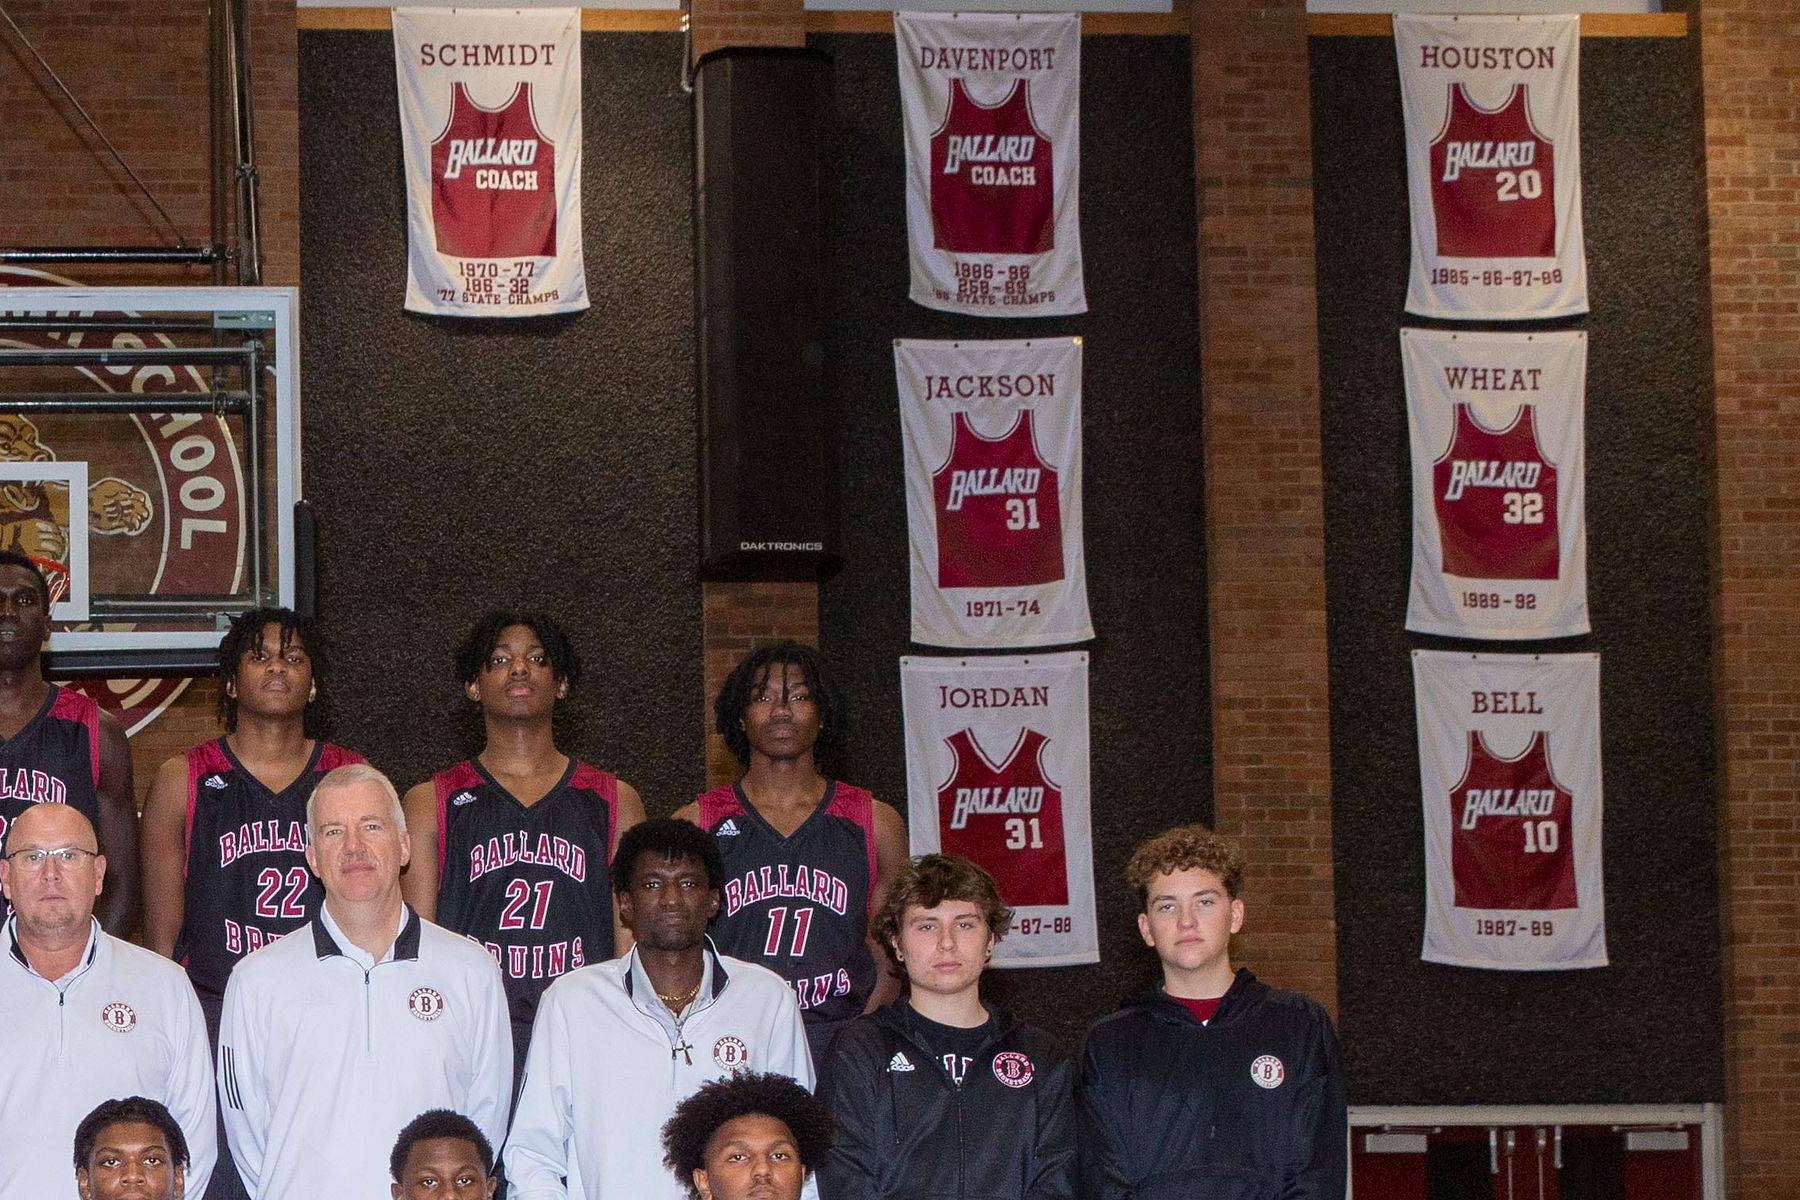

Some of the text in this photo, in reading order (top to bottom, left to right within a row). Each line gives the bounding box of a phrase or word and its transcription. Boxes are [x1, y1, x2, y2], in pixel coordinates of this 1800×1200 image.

[421, 44, 556, 66] SCHMIDT
[921, 47, 1056, 70] DAVENPORT
[1421, 46, 1555, 70] HOUSTON
[444, 139, 539, 179] BALLARD
[944, 136, 1036, 175] BALLARD
[1443, 141, 1535, 182] BALLARD
[476, 170, 538, 191] COACH
[971, 166, 1036, 186] COACH
[1495, 169, 1542, 201] 20
[462, 292, 501, 305] STATE
[508, 290, 559, 305] CHAMPS
[1003, 291, 1056, 305] CHAMPS
[925, 374, 1055, 400] JACKSON
[1444, 367, 1542, 391] WHEAT
[946, 468, 1040, 511] BALLARD
[1444, 460, 1541, 501] BALLARD
[1006, 498, 1040, 530] 31
[1503, 492, 1544, 525] 32
[740, 541, 823, 551] DAKTRONICS
[966, 601, 1040, 617] 1971-74
[939, 685, 1049, 708] JORDAN
[1471, 691, 1543, 715] BELL
[950, 787, 1044, 829] BALLARD
[1461, 789, 1555, 830] BALLARD
[1005, 817, 1044, 849] 31
[1522, 820, 1558, 853] 10
[470, 830, 586, 883] BALLARD
[256, 867, 309, 918] 22
[499, 878, 554, 930] 21
[725, 864, 848, 917] BALLARD
[764, 907, 814, 956] 11
